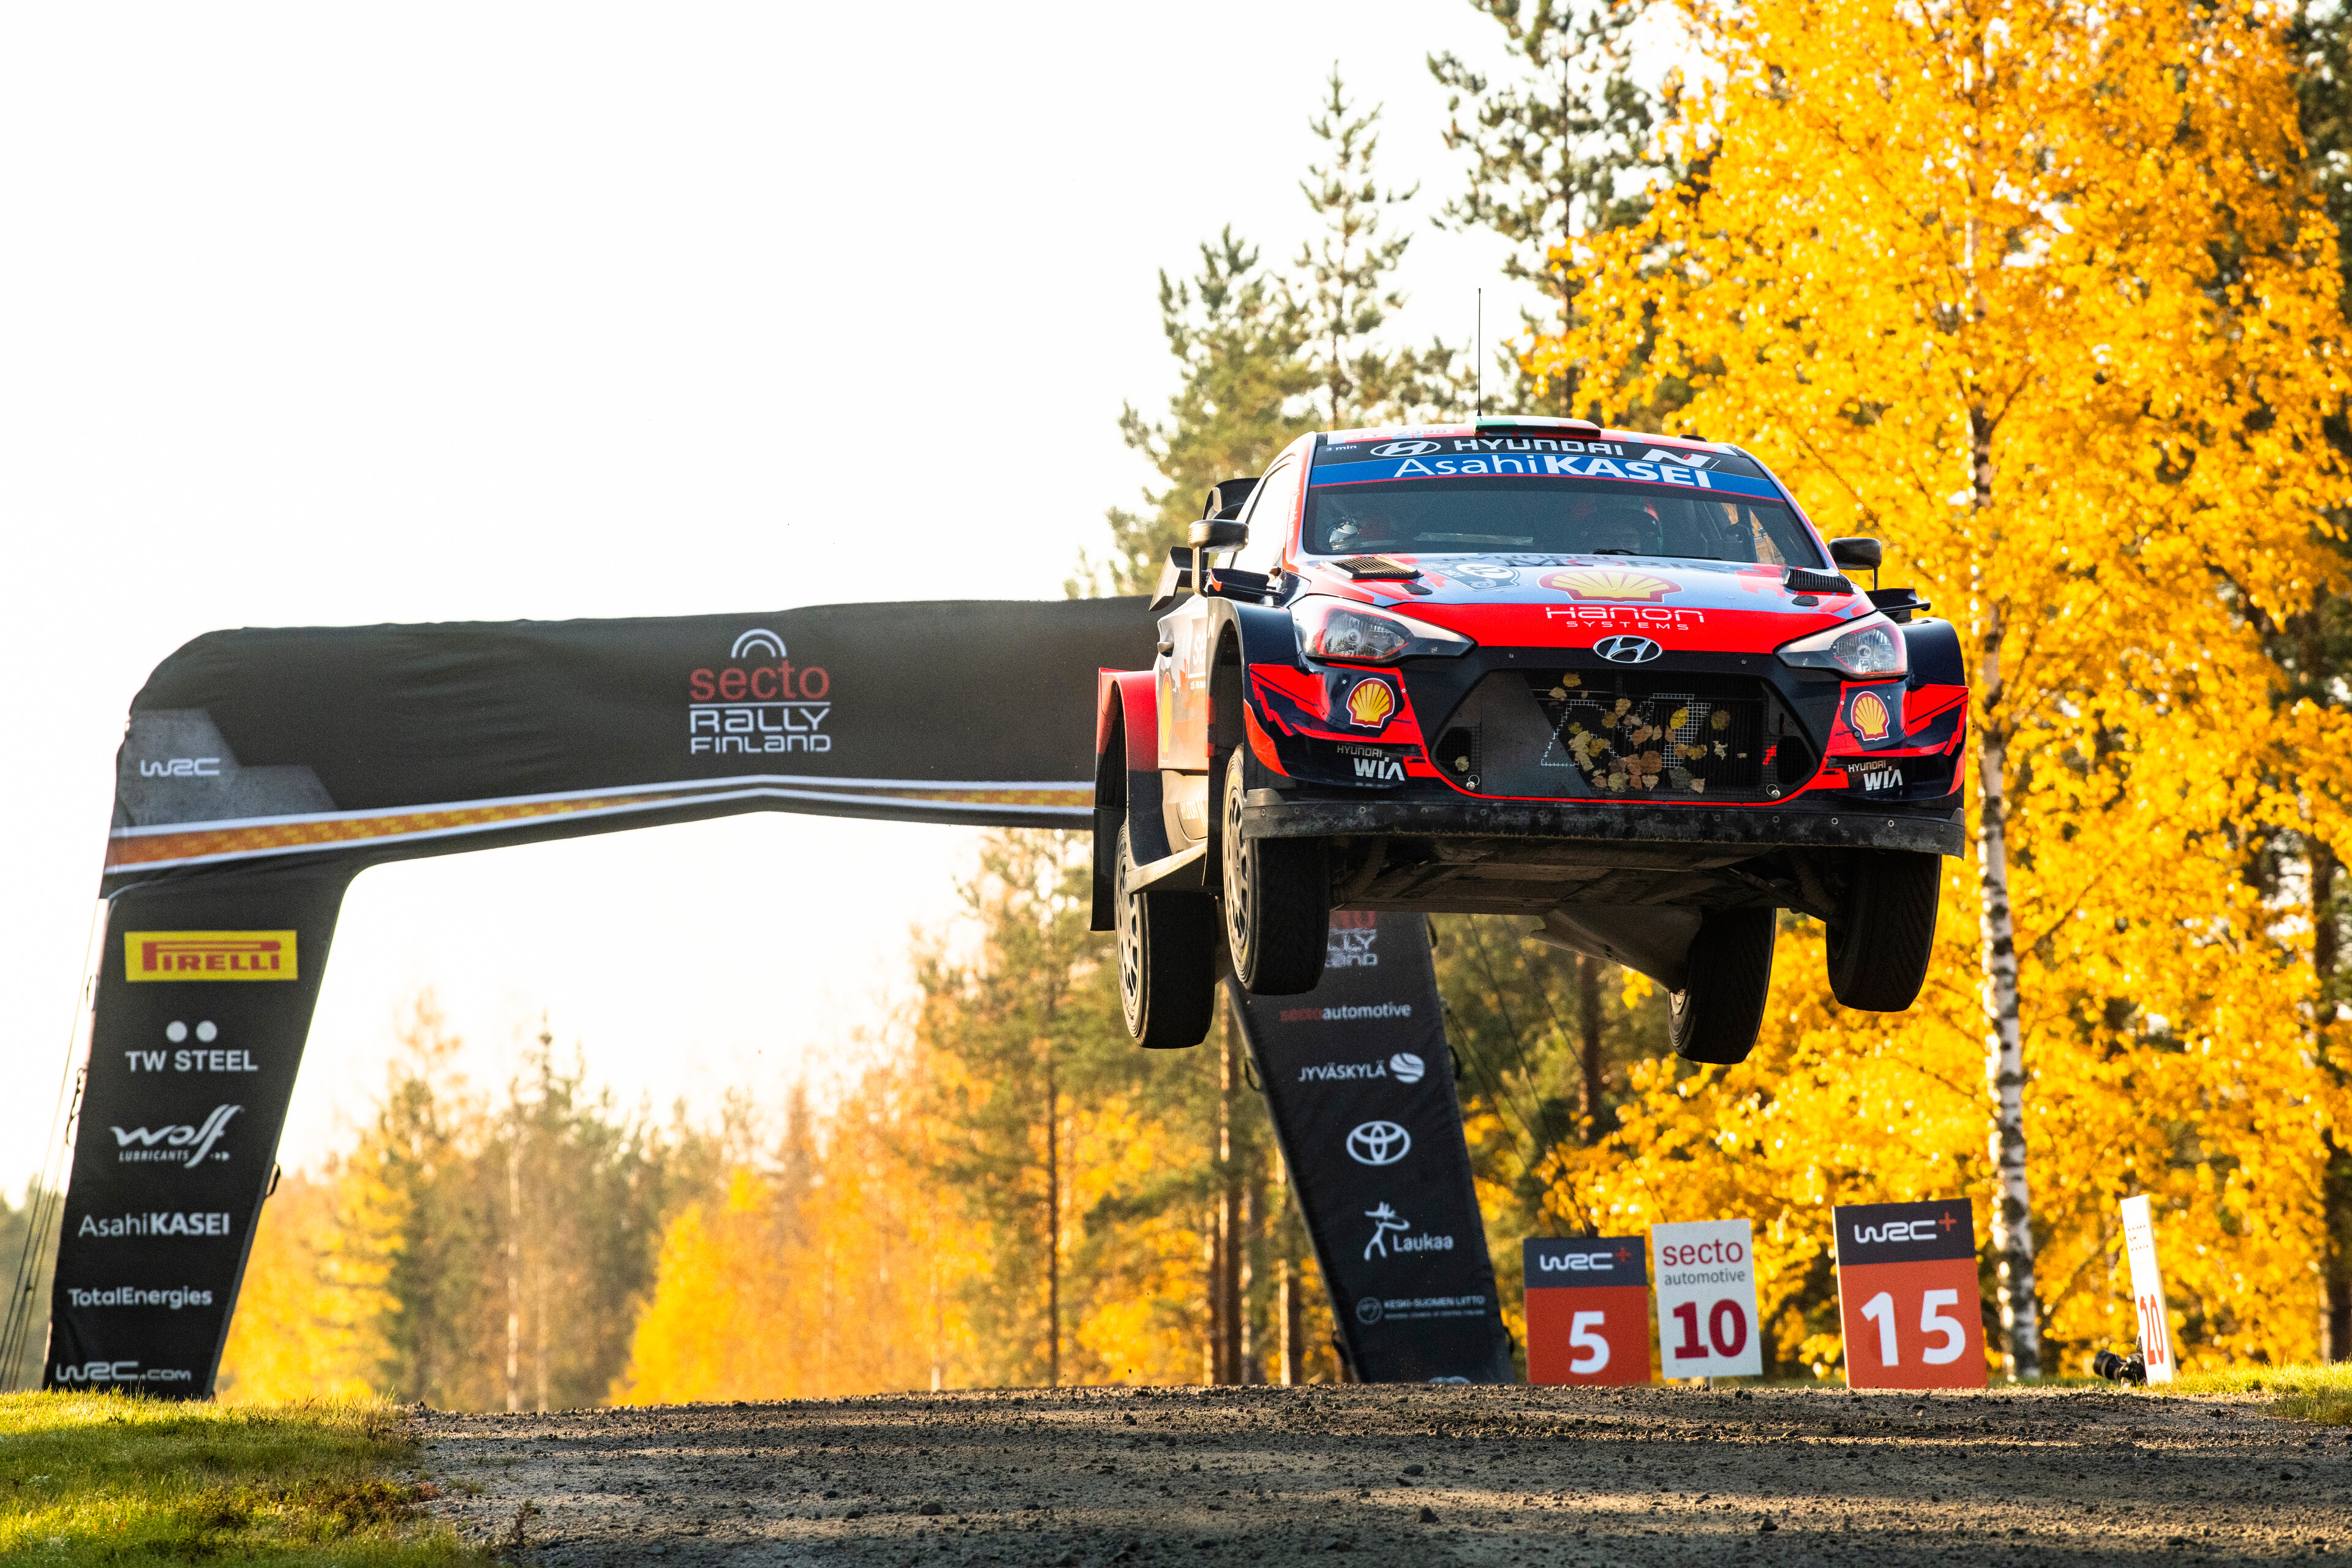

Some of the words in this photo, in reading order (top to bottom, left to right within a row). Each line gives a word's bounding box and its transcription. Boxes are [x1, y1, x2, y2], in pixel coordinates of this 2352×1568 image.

[1453, 439, 1624, 456] HYUNDAI
[1393, 454, 1712, 488] AsahiKASEI
[1566, 621, 1689, 631] SYSTEMS
[690, 660, 830, 701] secto
[1337, 745, 1382, 758] HYUNDAI
[140, 757, 221, 777] WRC
[1849, 760, 1887, 772] HYUNDAI
[142, 940, 282, 971] PIRELLI
[125, 1050, 167, 1072] TW
[175, 1049, 259, 1072] STEEL
[1298, 1060, 1387, 1082] JYVÄSKYLÄ
[118, 1150, 189, 1163] LUBRICANTS
[78, 1212, 230, 1238] AsahiKASEI
[1393, 1232, 1454, 1253] Laukaa
[1662, 1238, 1744, 1267] secto
[1664, 1267, 1746, 1286] automotive
[67, 1286, 213, 1310] TotalEnergies
[1673, 1298, 1747, 1359] 10
[1860, 1288, 1966, 1367] 15
[2140, 1292, 2165, 1366] 20
[1569, 1310, 1610, 1374] 5
[56, 1360, 192, 1383] WRC.com
